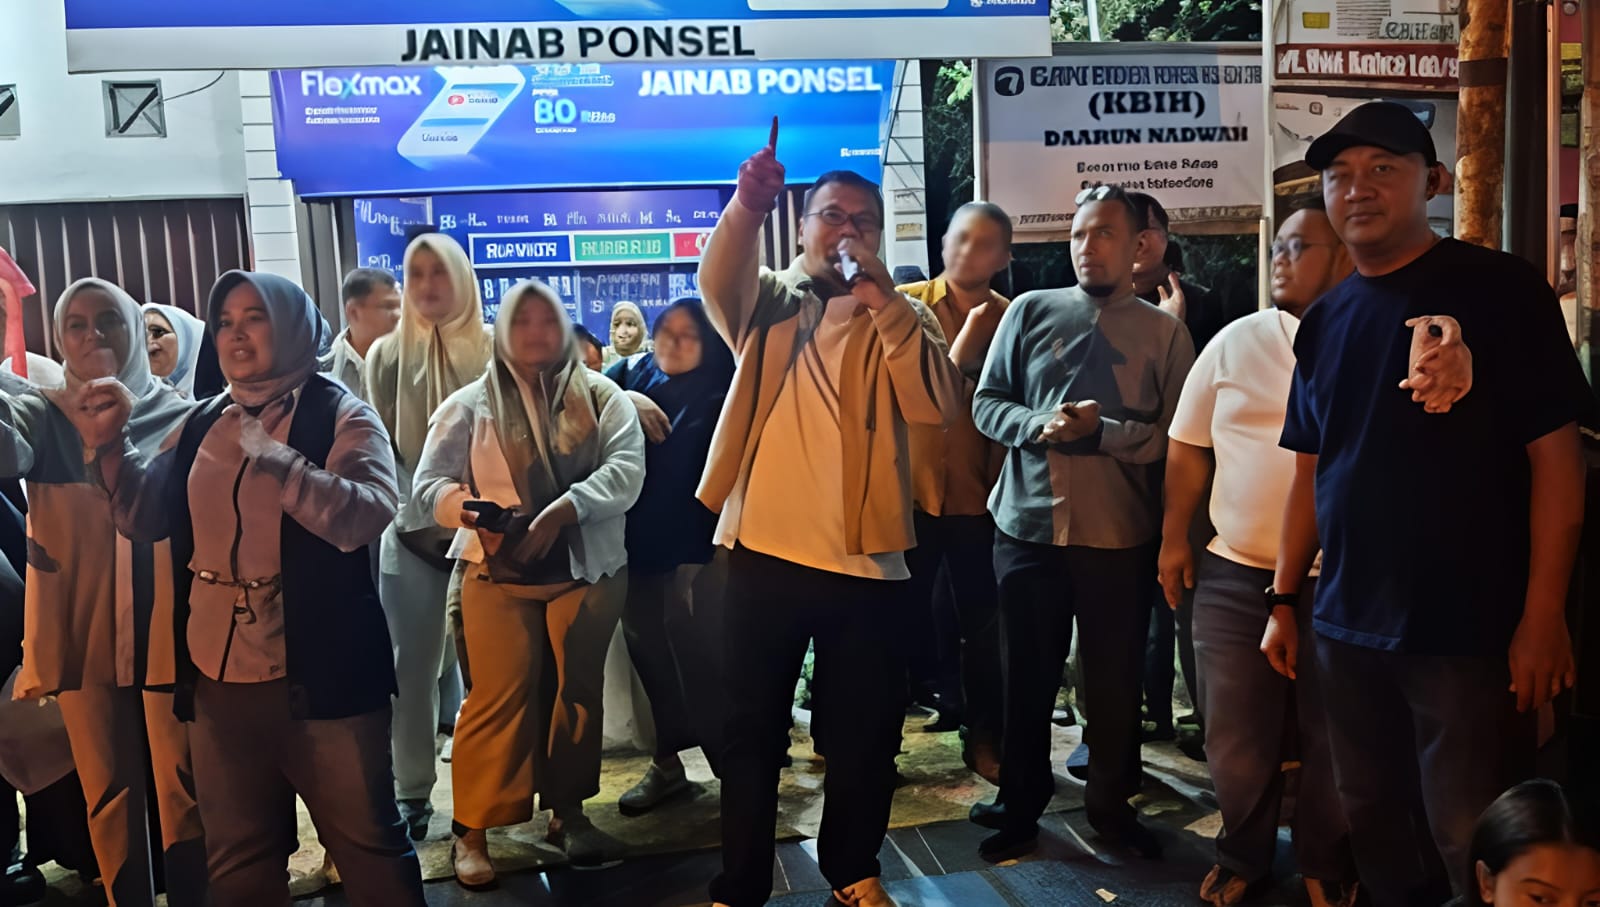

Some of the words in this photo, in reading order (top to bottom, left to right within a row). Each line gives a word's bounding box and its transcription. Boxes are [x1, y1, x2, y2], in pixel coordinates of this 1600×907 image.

[401, 28, 564, 61] JAINAB
[578, 26, 755, 57] PONSEL
[638, 69, 752, 96] JAINAB
[757, 67, 883, 94] PONSEL
[1089, 91, 1205, 121] (KBIH)
[1044, 130, 1141, 146] DAARUN
[1148, 127, 1248, 144] NADWAH
